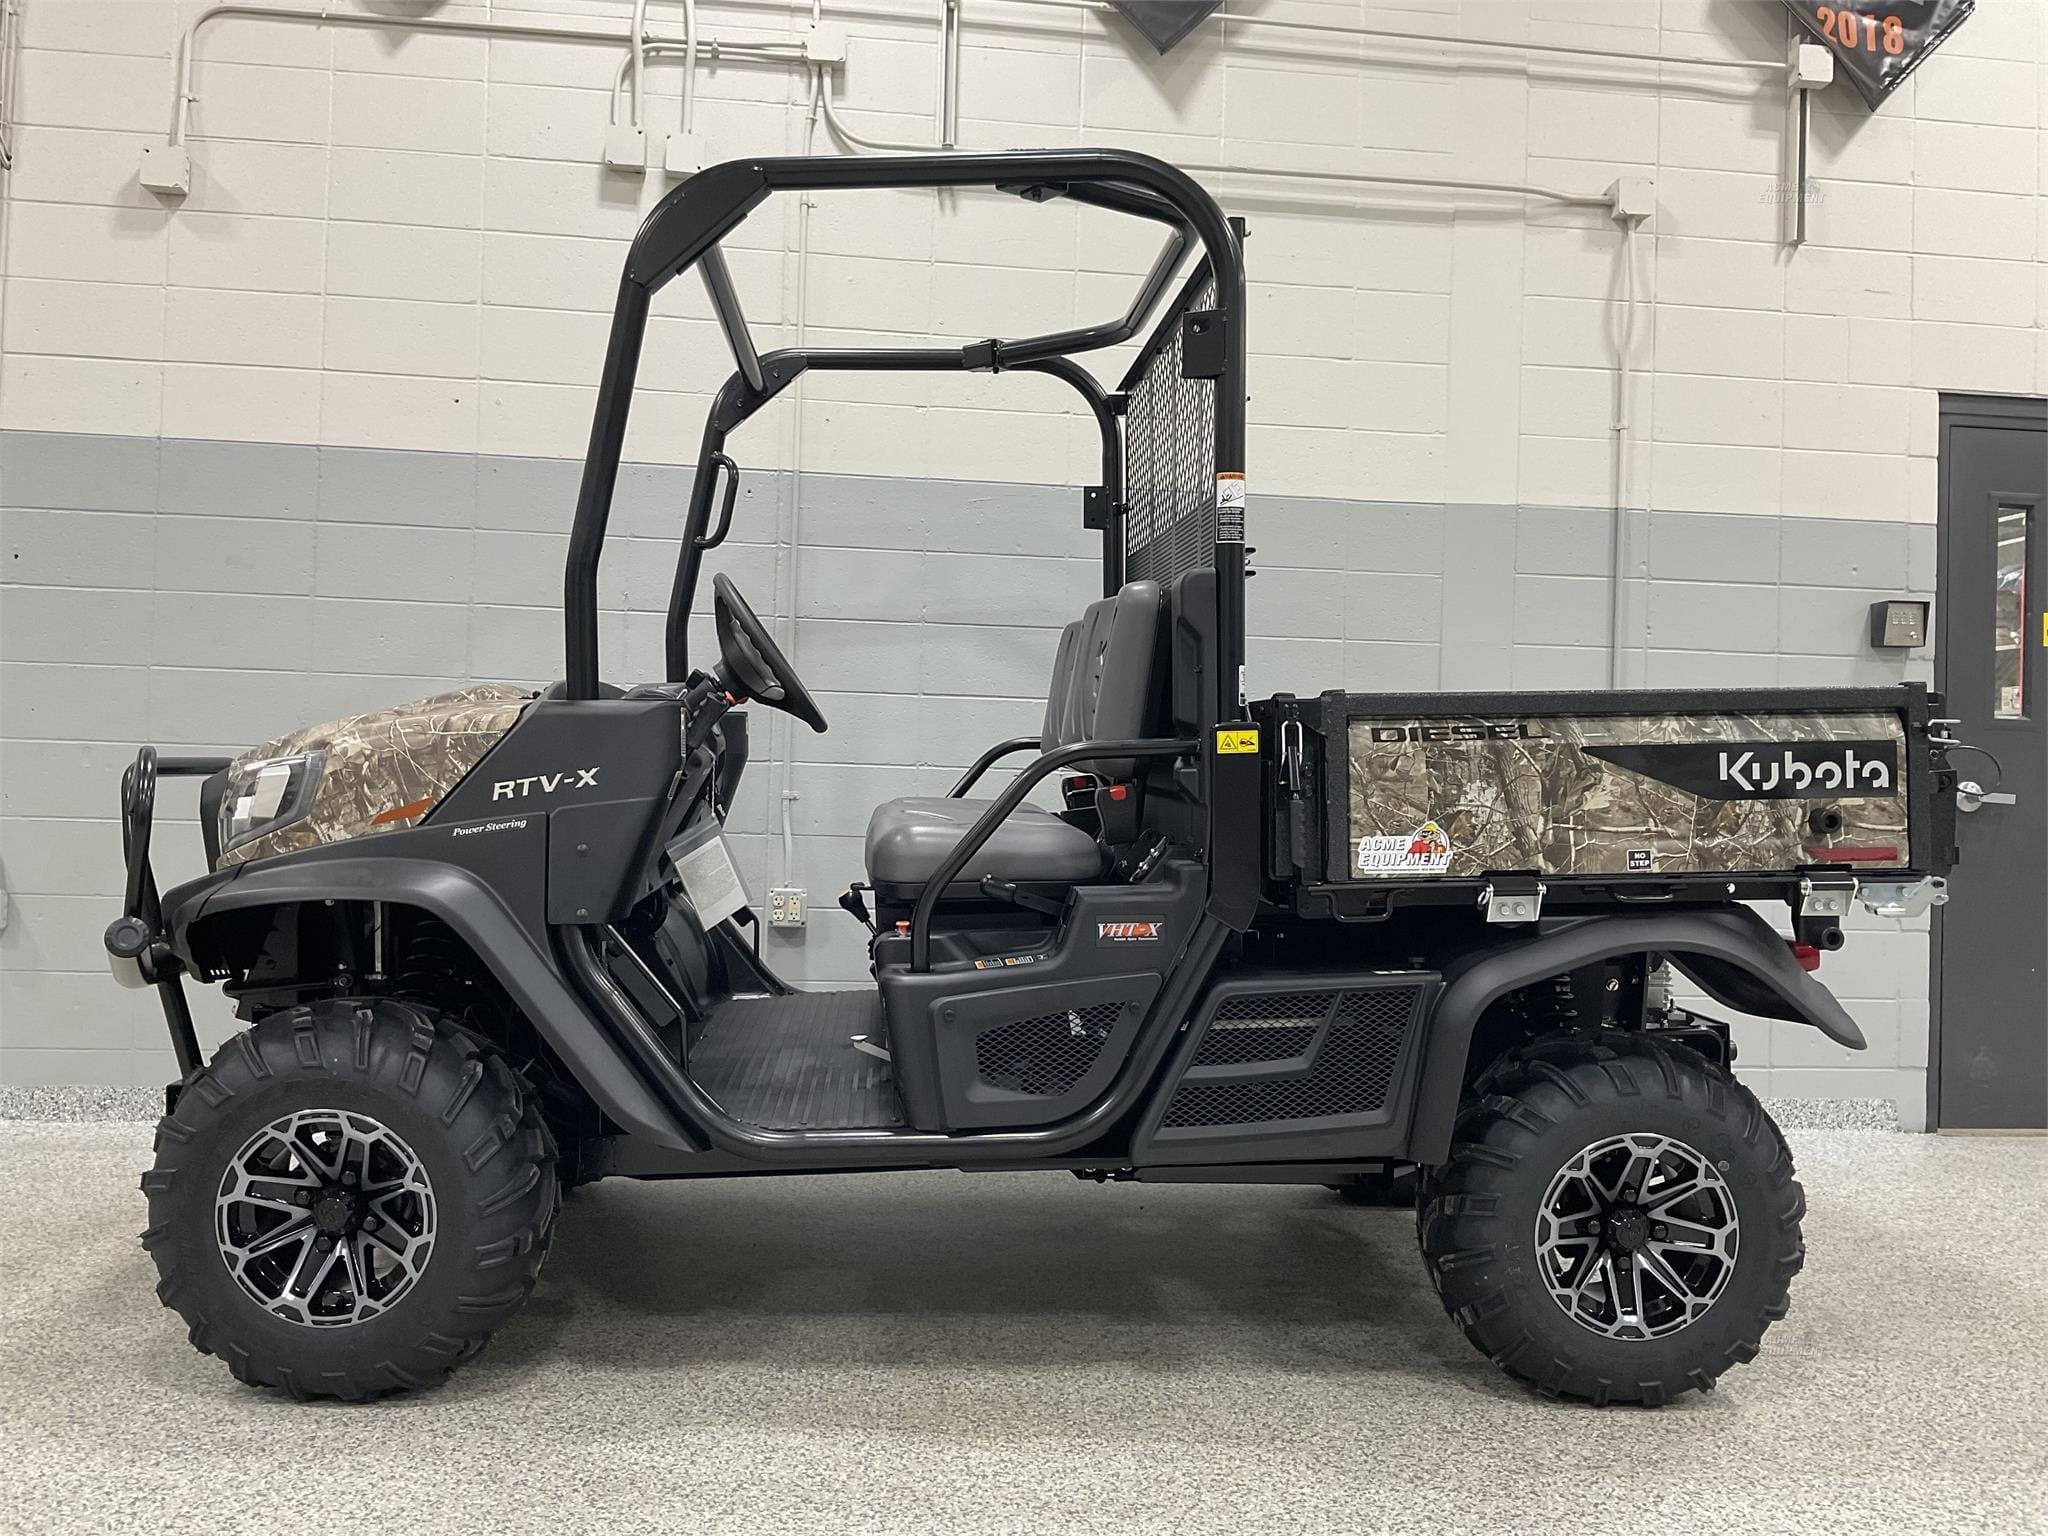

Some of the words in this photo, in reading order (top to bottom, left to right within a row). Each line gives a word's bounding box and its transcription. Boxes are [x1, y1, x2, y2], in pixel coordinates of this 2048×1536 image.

[1816, 6, 1905, 55] 2018
[1371, 724, 1551, 743] DIESEL
[1719, 749, 1890, 792] Kubota
[492, 766, 601, 801] RTV-X
[452, 826, 485, 837] Power
[485, 819, 528, 832] Steering
[1360, 838, 1406, 851] ACME
[1360, 852, 1453, 867] EQUIPMENT
[1634, 852, 1646, 860] NO
[1097, 922, 1163, 940] VHT-X
